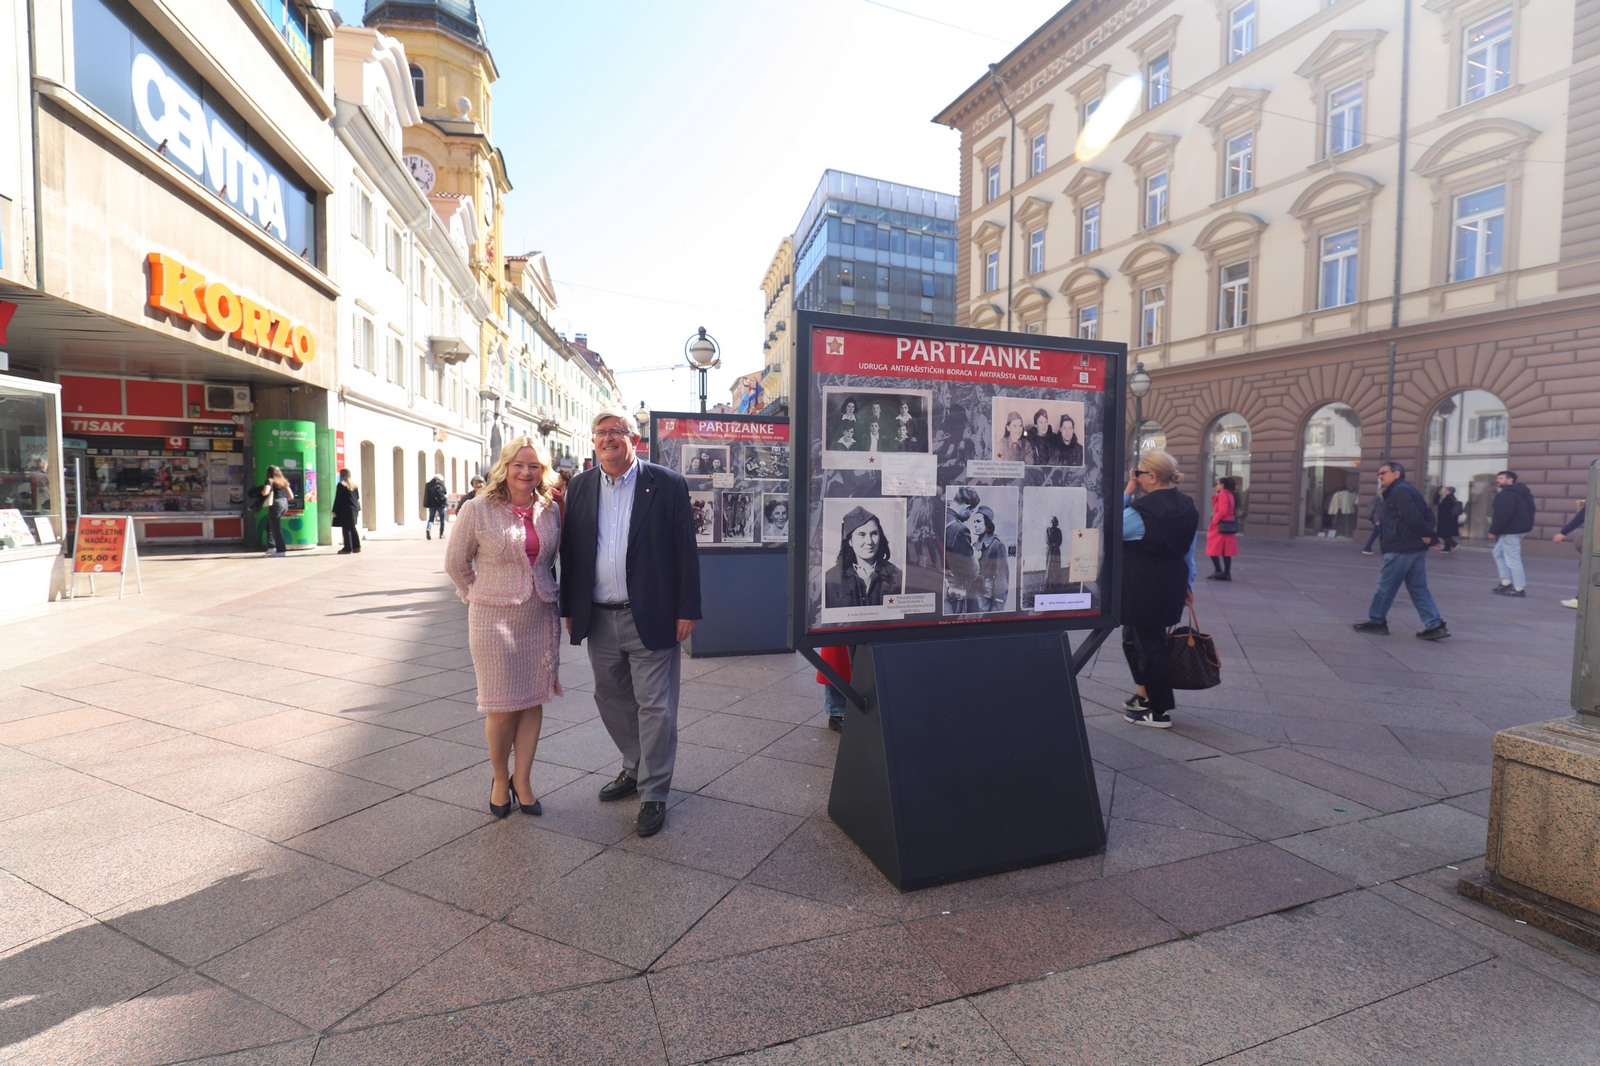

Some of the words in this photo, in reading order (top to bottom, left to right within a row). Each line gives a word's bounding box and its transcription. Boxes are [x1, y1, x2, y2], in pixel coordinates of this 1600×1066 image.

[131, 53, 287, 241] CENTRA
[148, 252, 315, 363] KORZO
[859, 362, 888, 371] UDRUGA
[890, 364, 944, 375] ANTIFAŠISTIČKIH
[947, 368, 972, 377] BORACA
[979, 370, 1016, 380] ANTIFAŠISTA
[1018, 373, 1038, 382] GRADA
[1040, 376, 1058, 384] RIJEKE
[71, 420, 125, 433] TISAK
